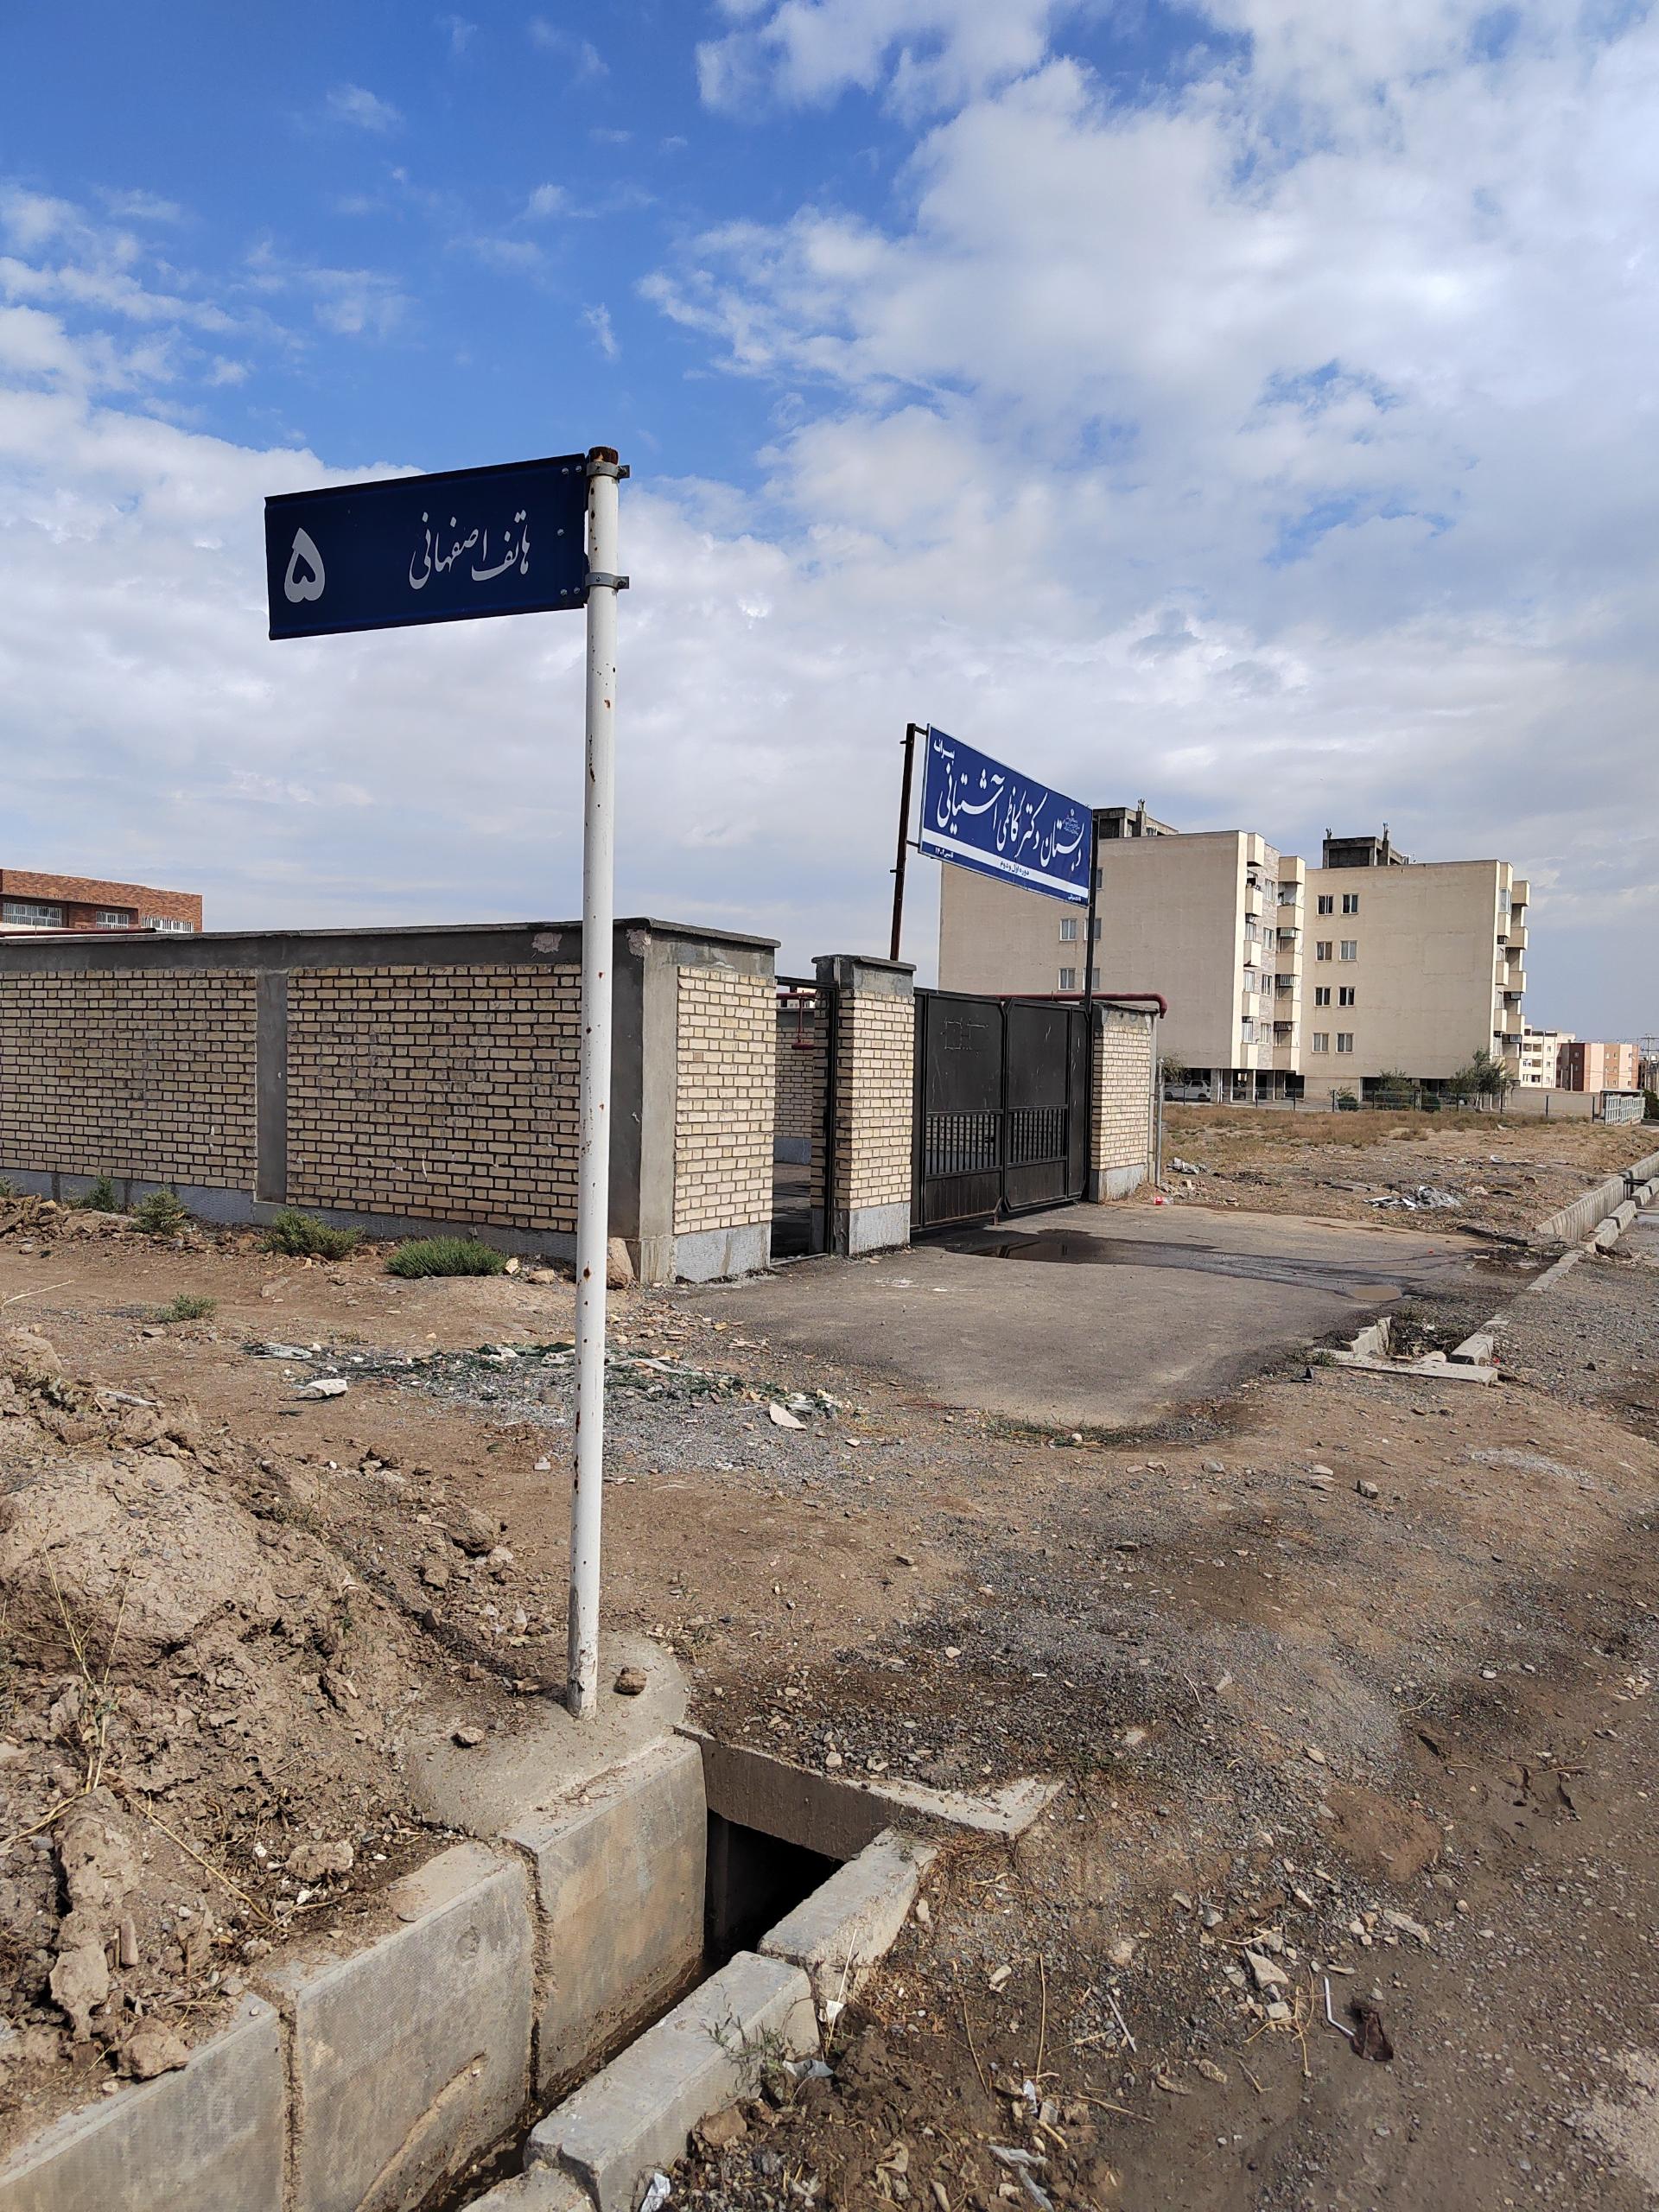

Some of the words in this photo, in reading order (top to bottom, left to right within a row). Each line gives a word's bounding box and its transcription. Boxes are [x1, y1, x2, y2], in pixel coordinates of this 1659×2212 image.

[284, 527, 326, 603] ۵
[409, 512, 487, 590] اصفهانی
[471, 509, 531, 582] هاتف
[933, 737, 955, 765] پسرانه
[937, 762, 1006, 835] آشتیانی
[996, 785, 1027, 852] کاظمی
[1014, 791, 1048, 858] دکتر
[1000, 861, 1008, 869] دوم
[1020, 868, 1030, 876] دوره
[1040, 818, 1085, 872] دبستان
